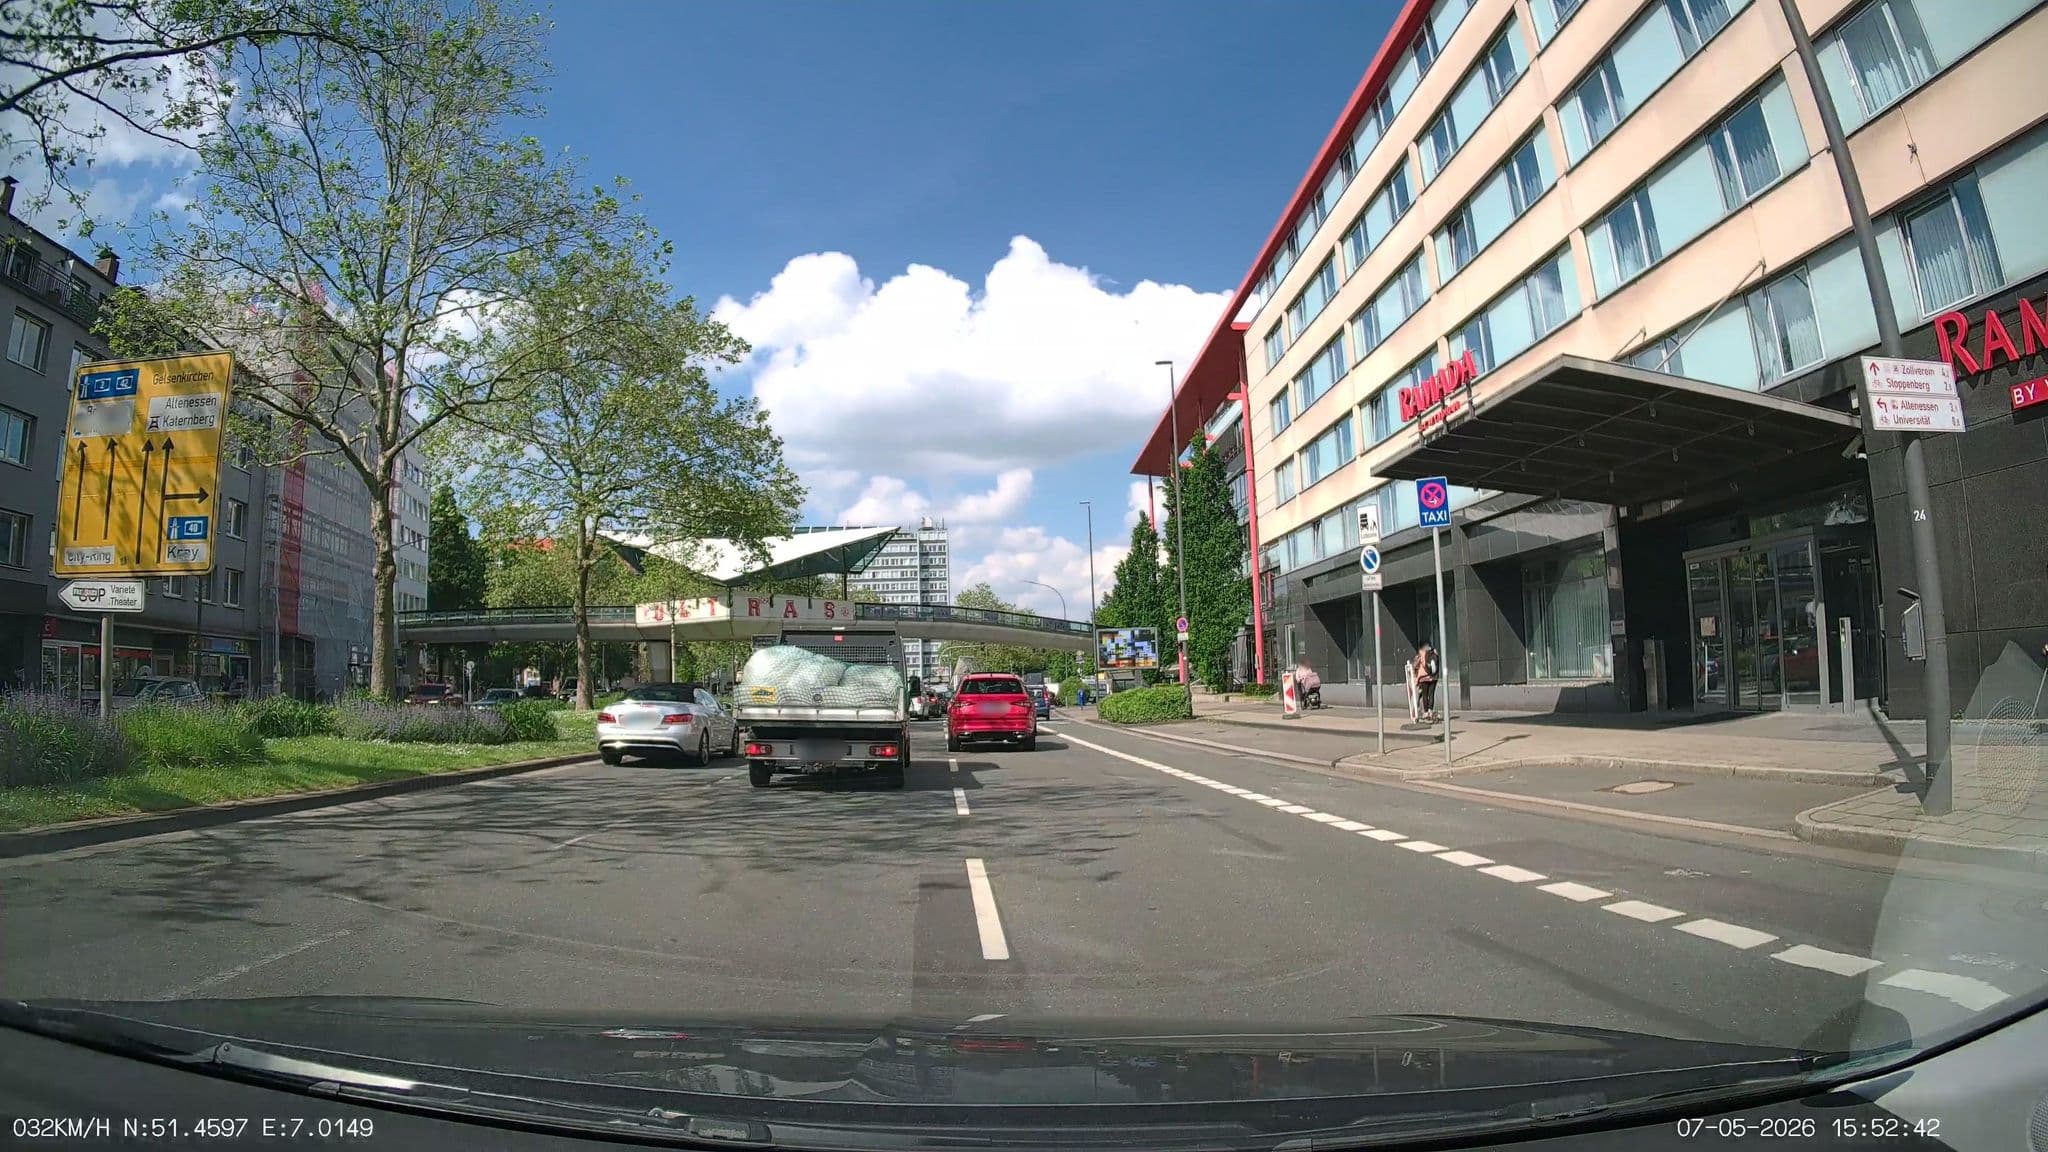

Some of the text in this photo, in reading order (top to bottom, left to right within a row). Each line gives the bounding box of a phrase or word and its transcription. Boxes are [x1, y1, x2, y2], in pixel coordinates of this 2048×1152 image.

[1901, 365, 1935, 376] Zollverein
[153, 371, 214, 385] Gelsenkirchen
[1399, 349, 1477, 422] RAMADA
[1886, 378, 1931, 392] Stoppenberg
[2013, 384, 2035, 405] BY
[165, 397, 217, 409] Altenessen
[1901, 400, 1939, 412] Altenessen
[163, 414, 215, 427] Katernberg
[1421, 510, 1447, 524] TAXI
[1913, 510, 1926, 522] 24
[110, 597, 137, 606] Theater
